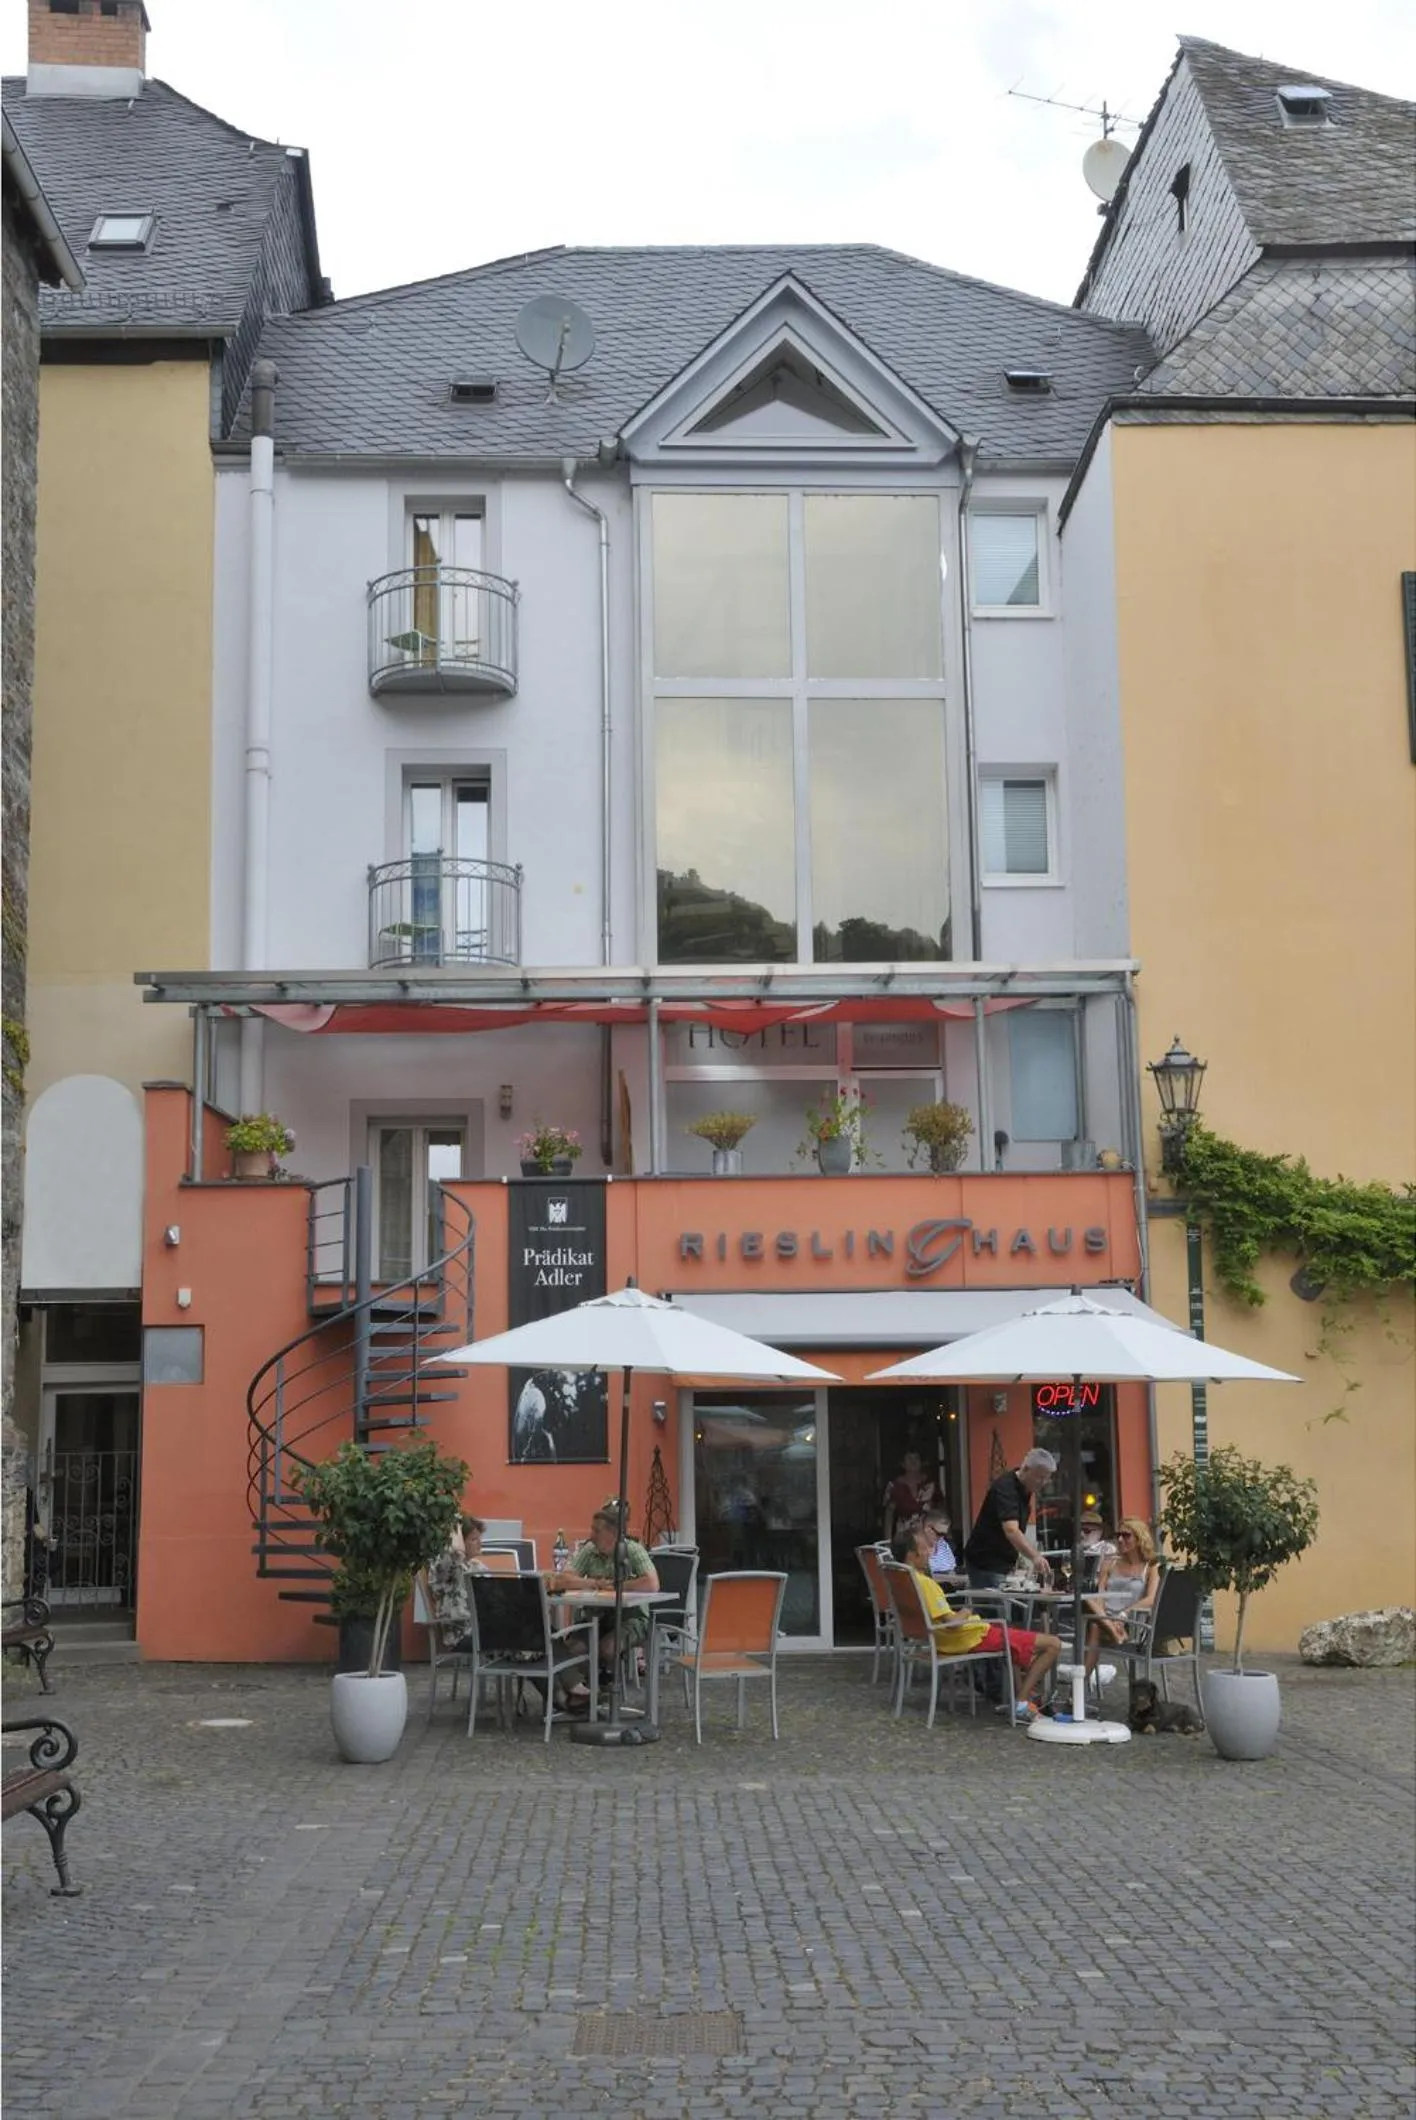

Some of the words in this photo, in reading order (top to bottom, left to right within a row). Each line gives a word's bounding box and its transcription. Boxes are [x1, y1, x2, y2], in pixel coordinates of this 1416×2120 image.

[523, 1247, 595, 1266] Prädikat
[533, 1267, 583, 1286] Adler
[1036, 1383, 1100, 1406] OPEN
